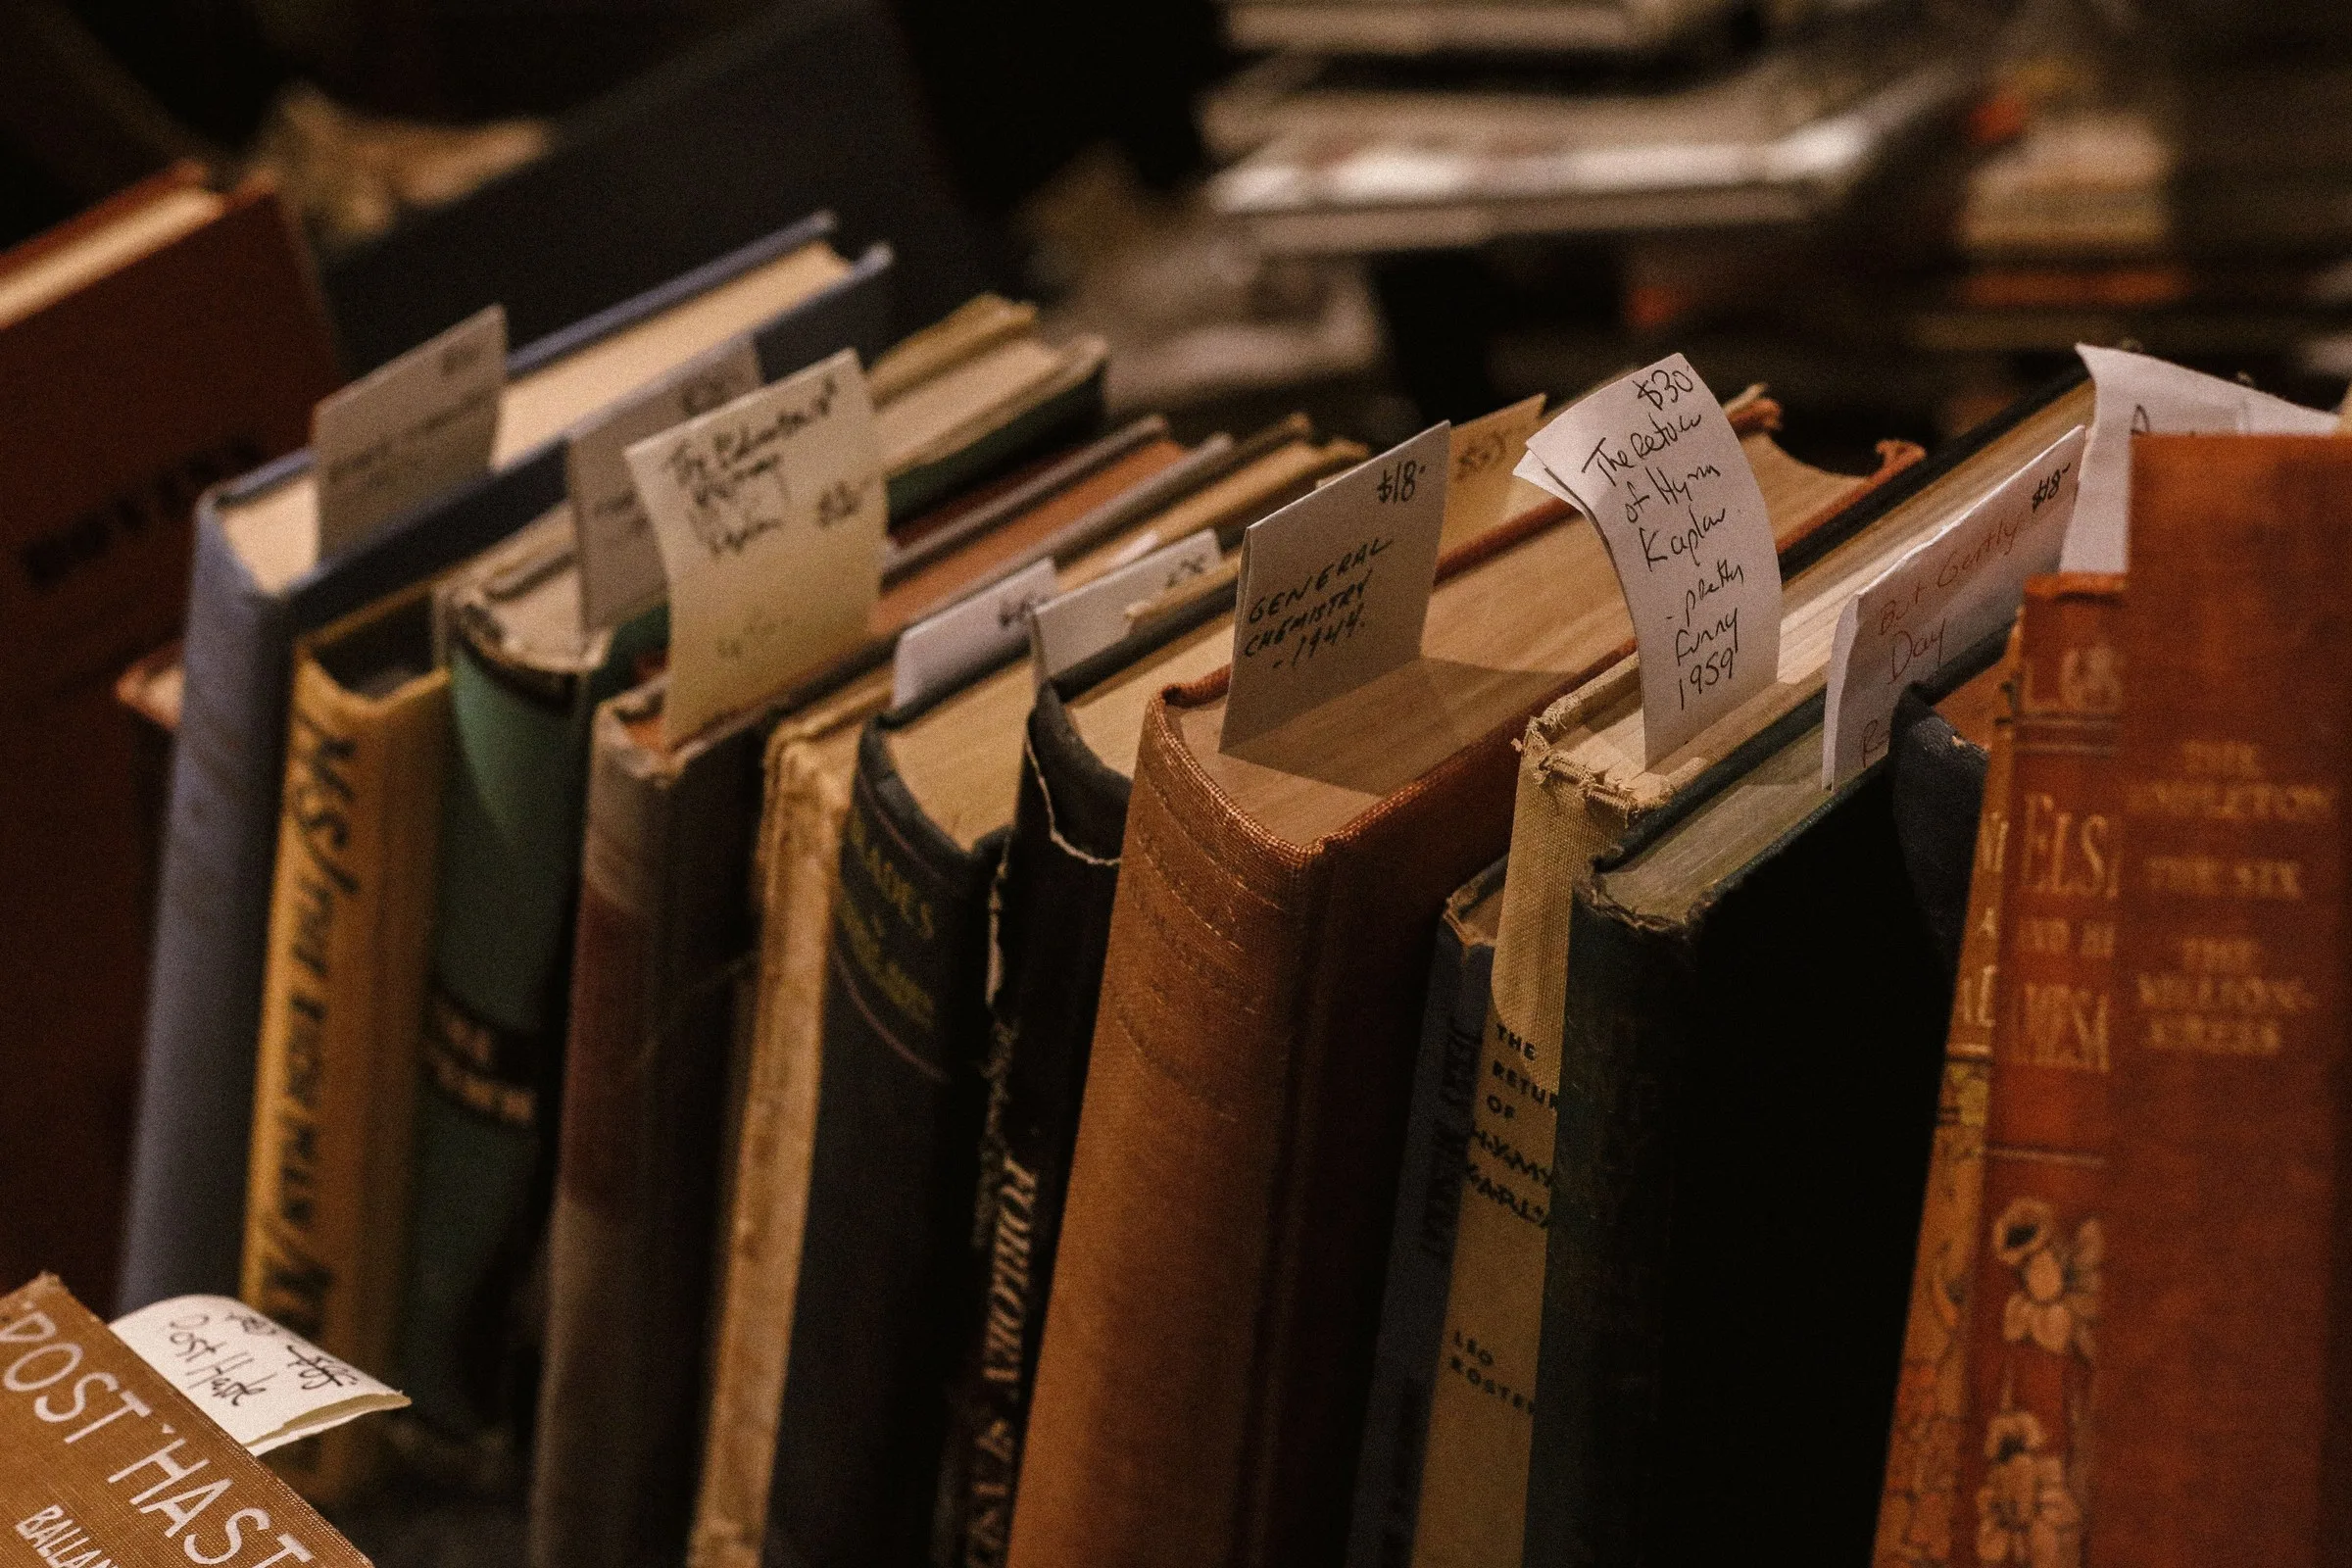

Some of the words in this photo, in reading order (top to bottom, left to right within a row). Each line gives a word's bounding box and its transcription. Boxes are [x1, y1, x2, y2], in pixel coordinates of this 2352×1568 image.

[1244, 567, 1374, 659] CHEMISTRY
[1248, 538, 1396, 624] GENERAL
[1887, 617, 1946, 686] Day
[1496, 1022, 1536, 1061] THE
[1487, 1094, 1515, 1118] OF
[1492, 1058, 1558, 1109] RETUR
[0, 1312, 153, 1445] POST
[1454, 1331, 1494, 1368] LEO
[108, 1438, 315, 1568] HAST
